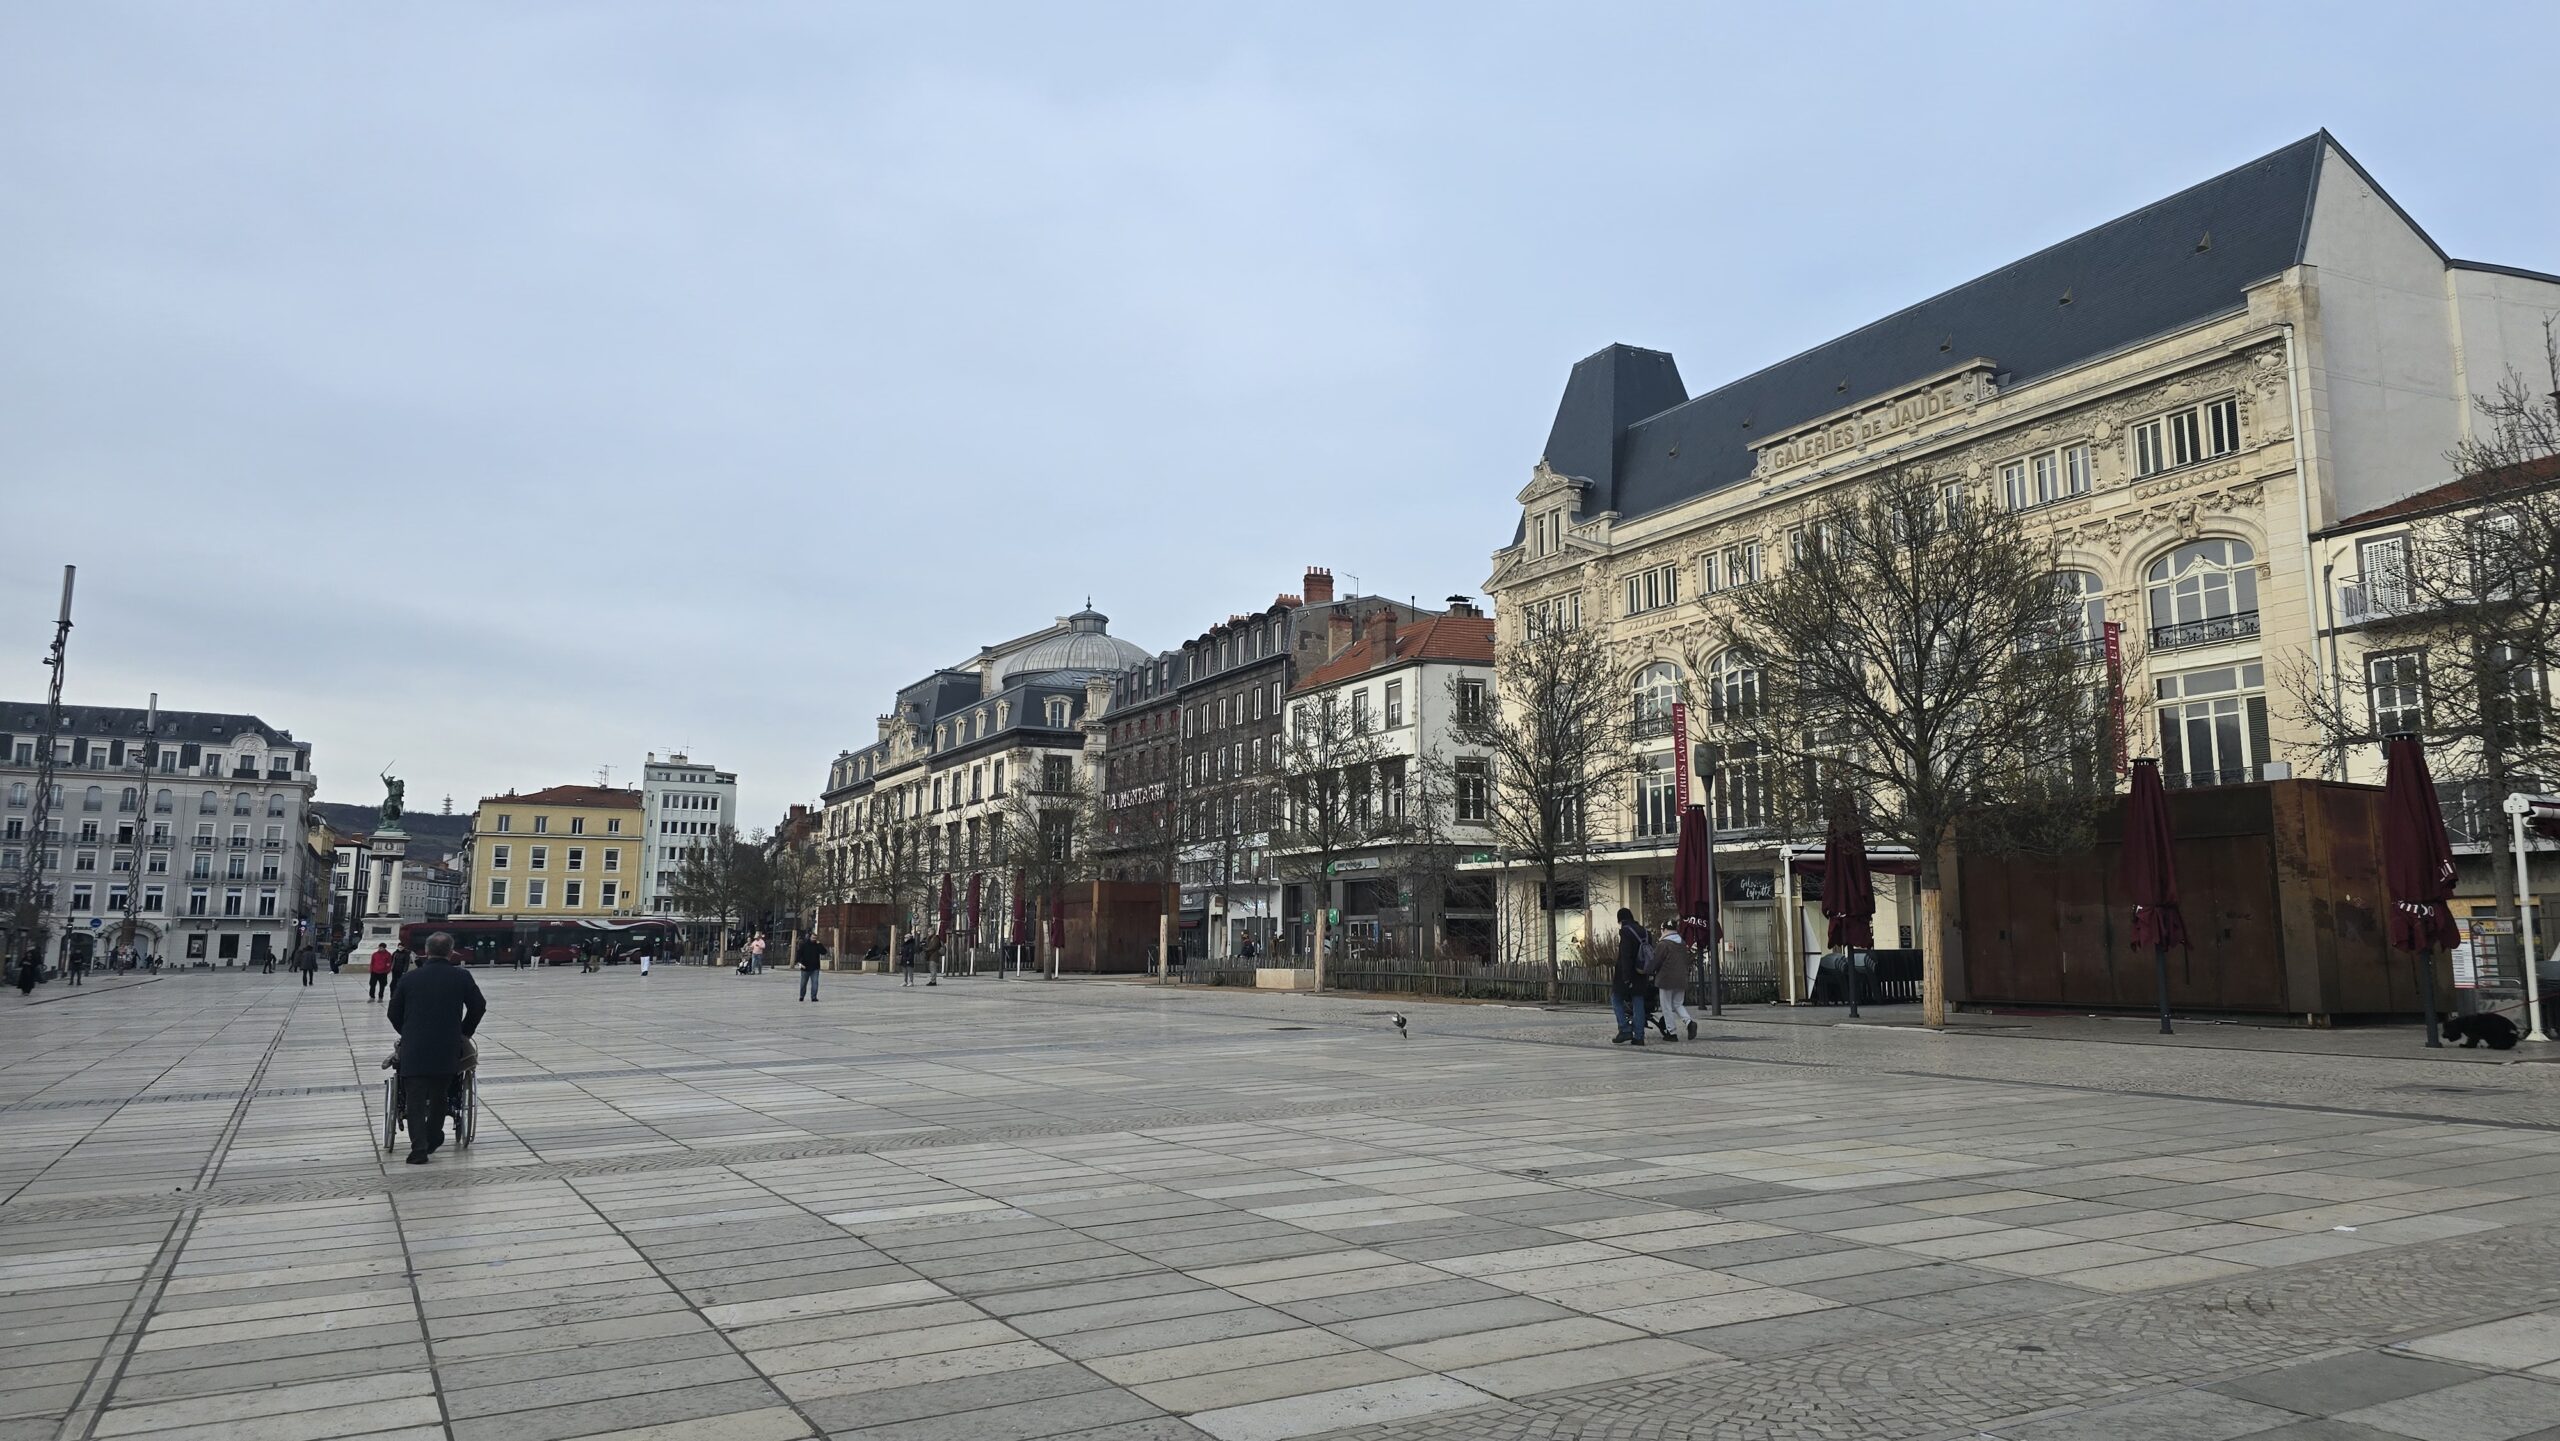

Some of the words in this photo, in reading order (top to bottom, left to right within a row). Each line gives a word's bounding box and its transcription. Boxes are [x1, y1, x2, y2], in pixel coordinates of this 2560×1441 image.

[1774, 427, 1855, 469] GALERIES
[1861, 420, 1883, 438] DE
[1889, 389, 1954, 429] JAUDE
[1676, 705, 1686, 762] LAFAYETTE
[1680, 765, 1688, 814] GALERIES
